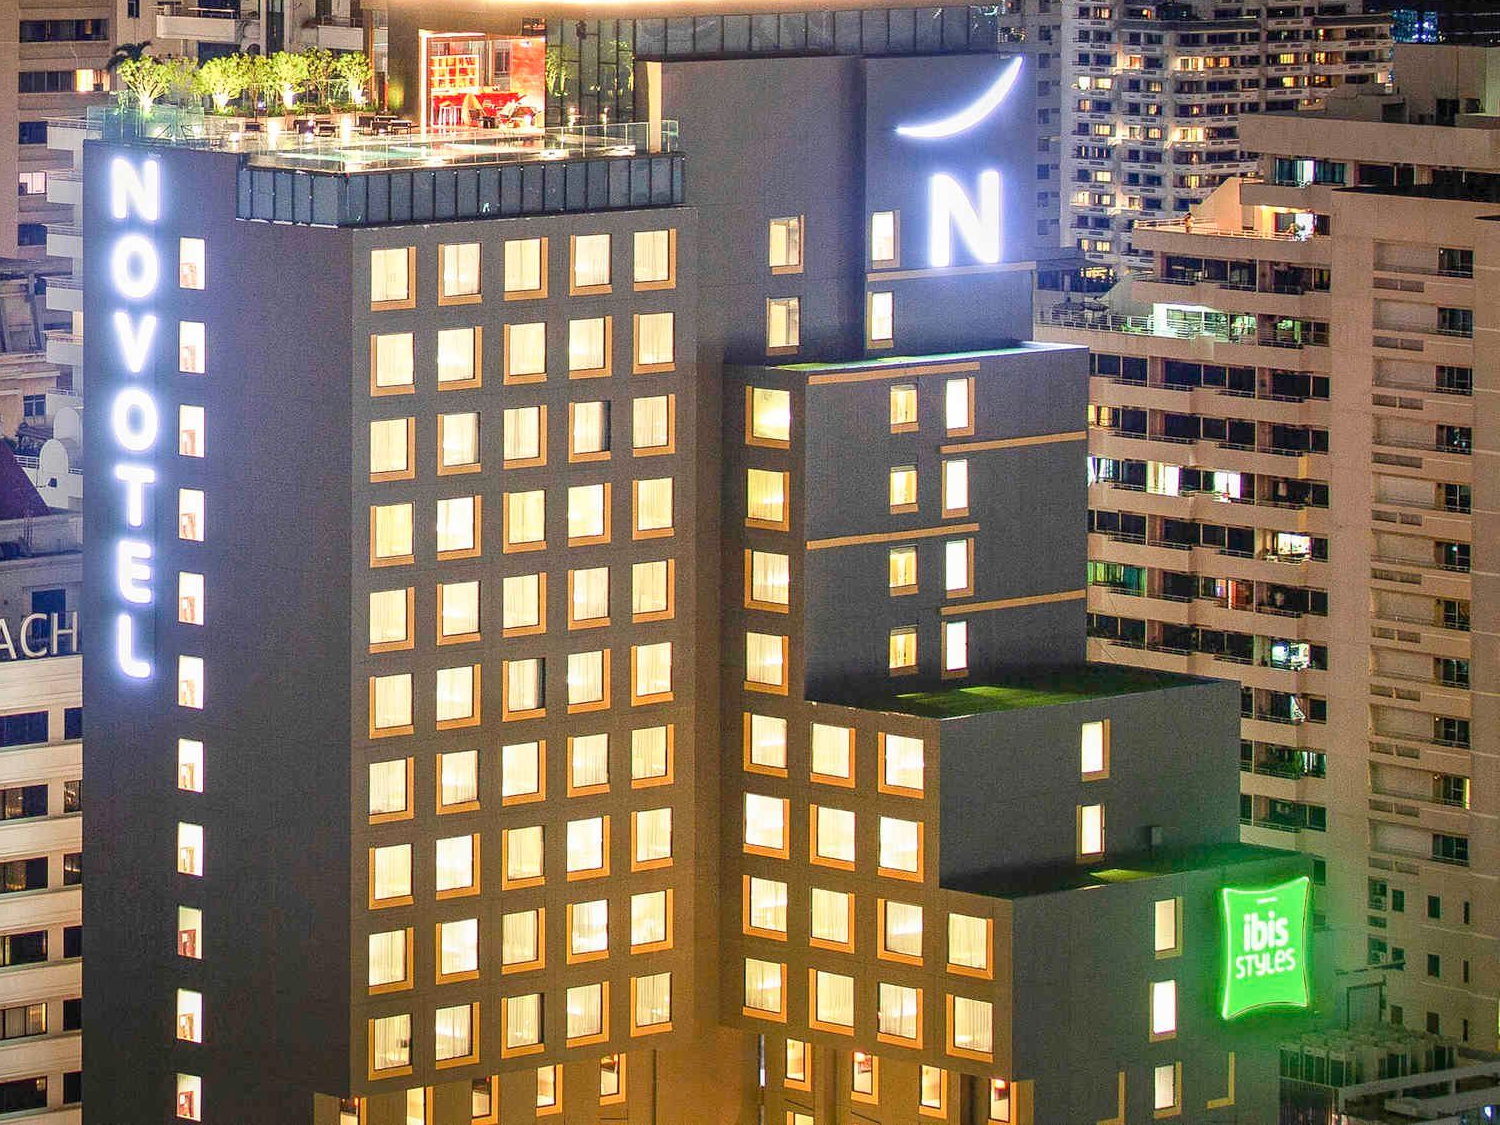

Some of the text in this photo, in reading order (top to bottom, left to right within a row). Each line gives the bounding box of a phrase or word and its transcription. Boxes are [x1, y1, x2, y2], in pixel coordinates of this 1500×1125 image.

[931, 170, 1001, 268] N
[111, 157, 159, 678] NOVOTEL
[1243, 910, 1289, 952] ibis
